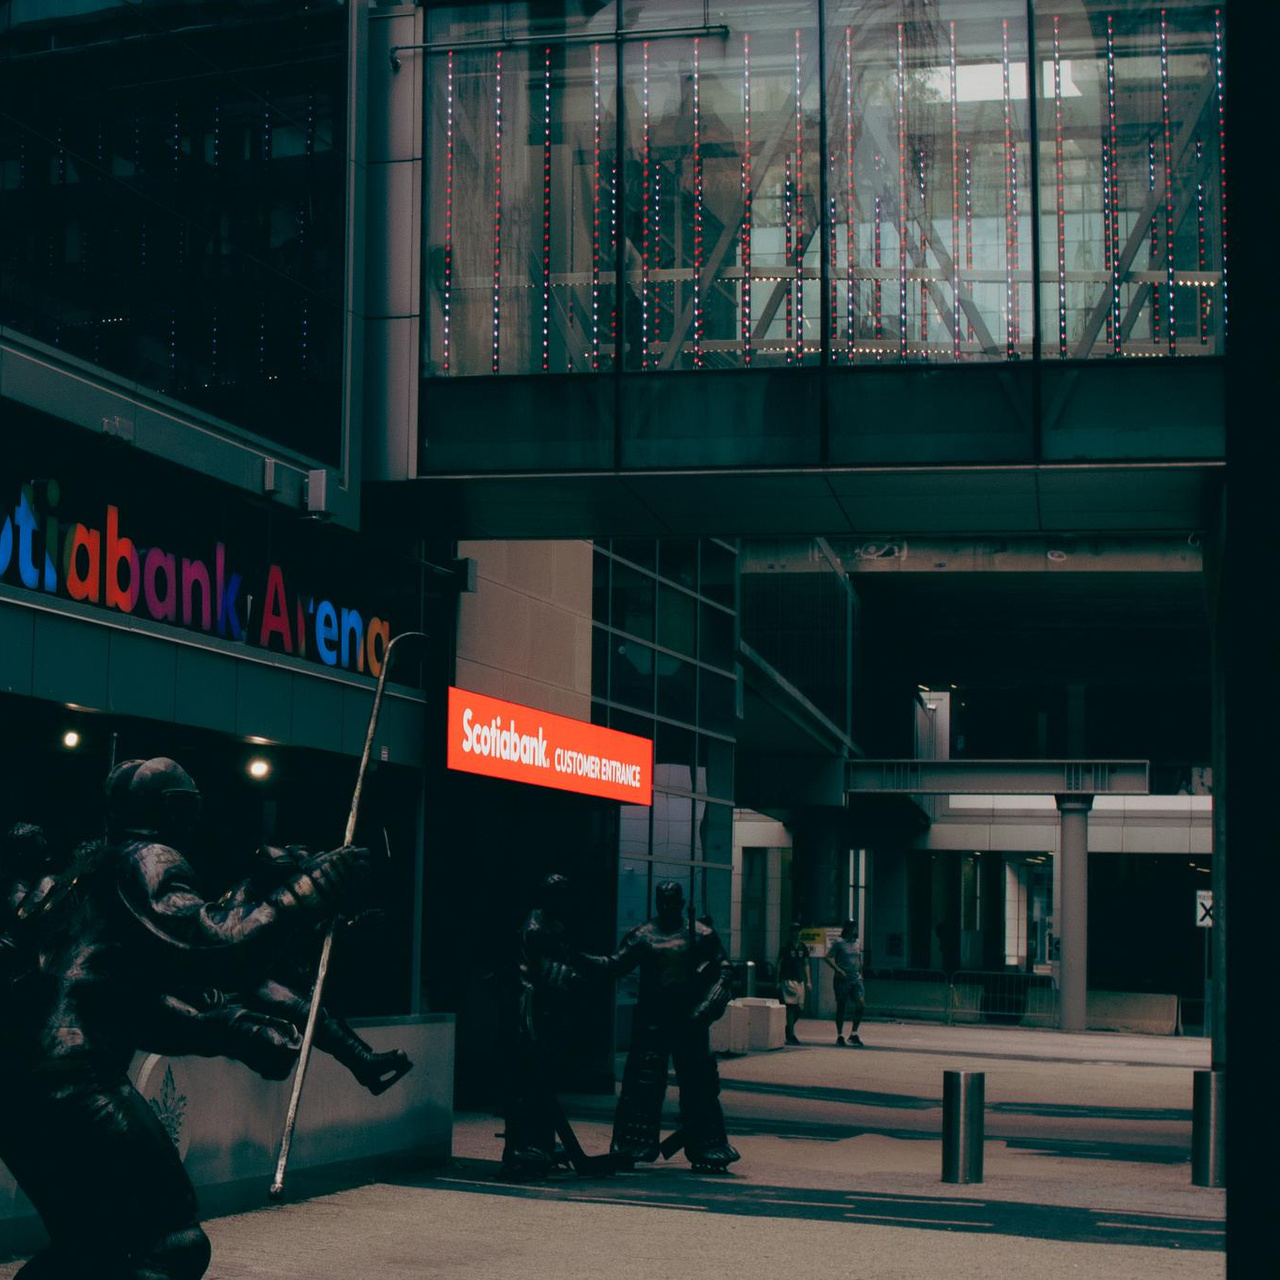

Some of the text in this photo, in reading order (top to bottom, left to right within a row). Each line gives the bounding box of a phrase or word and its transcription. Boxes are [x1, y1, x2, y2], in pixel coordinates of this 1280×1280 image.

[259, 564, 391, 678] Arena
[462, 708, 641, 788] Scotiabank CUSTOMER ENTRANCE
